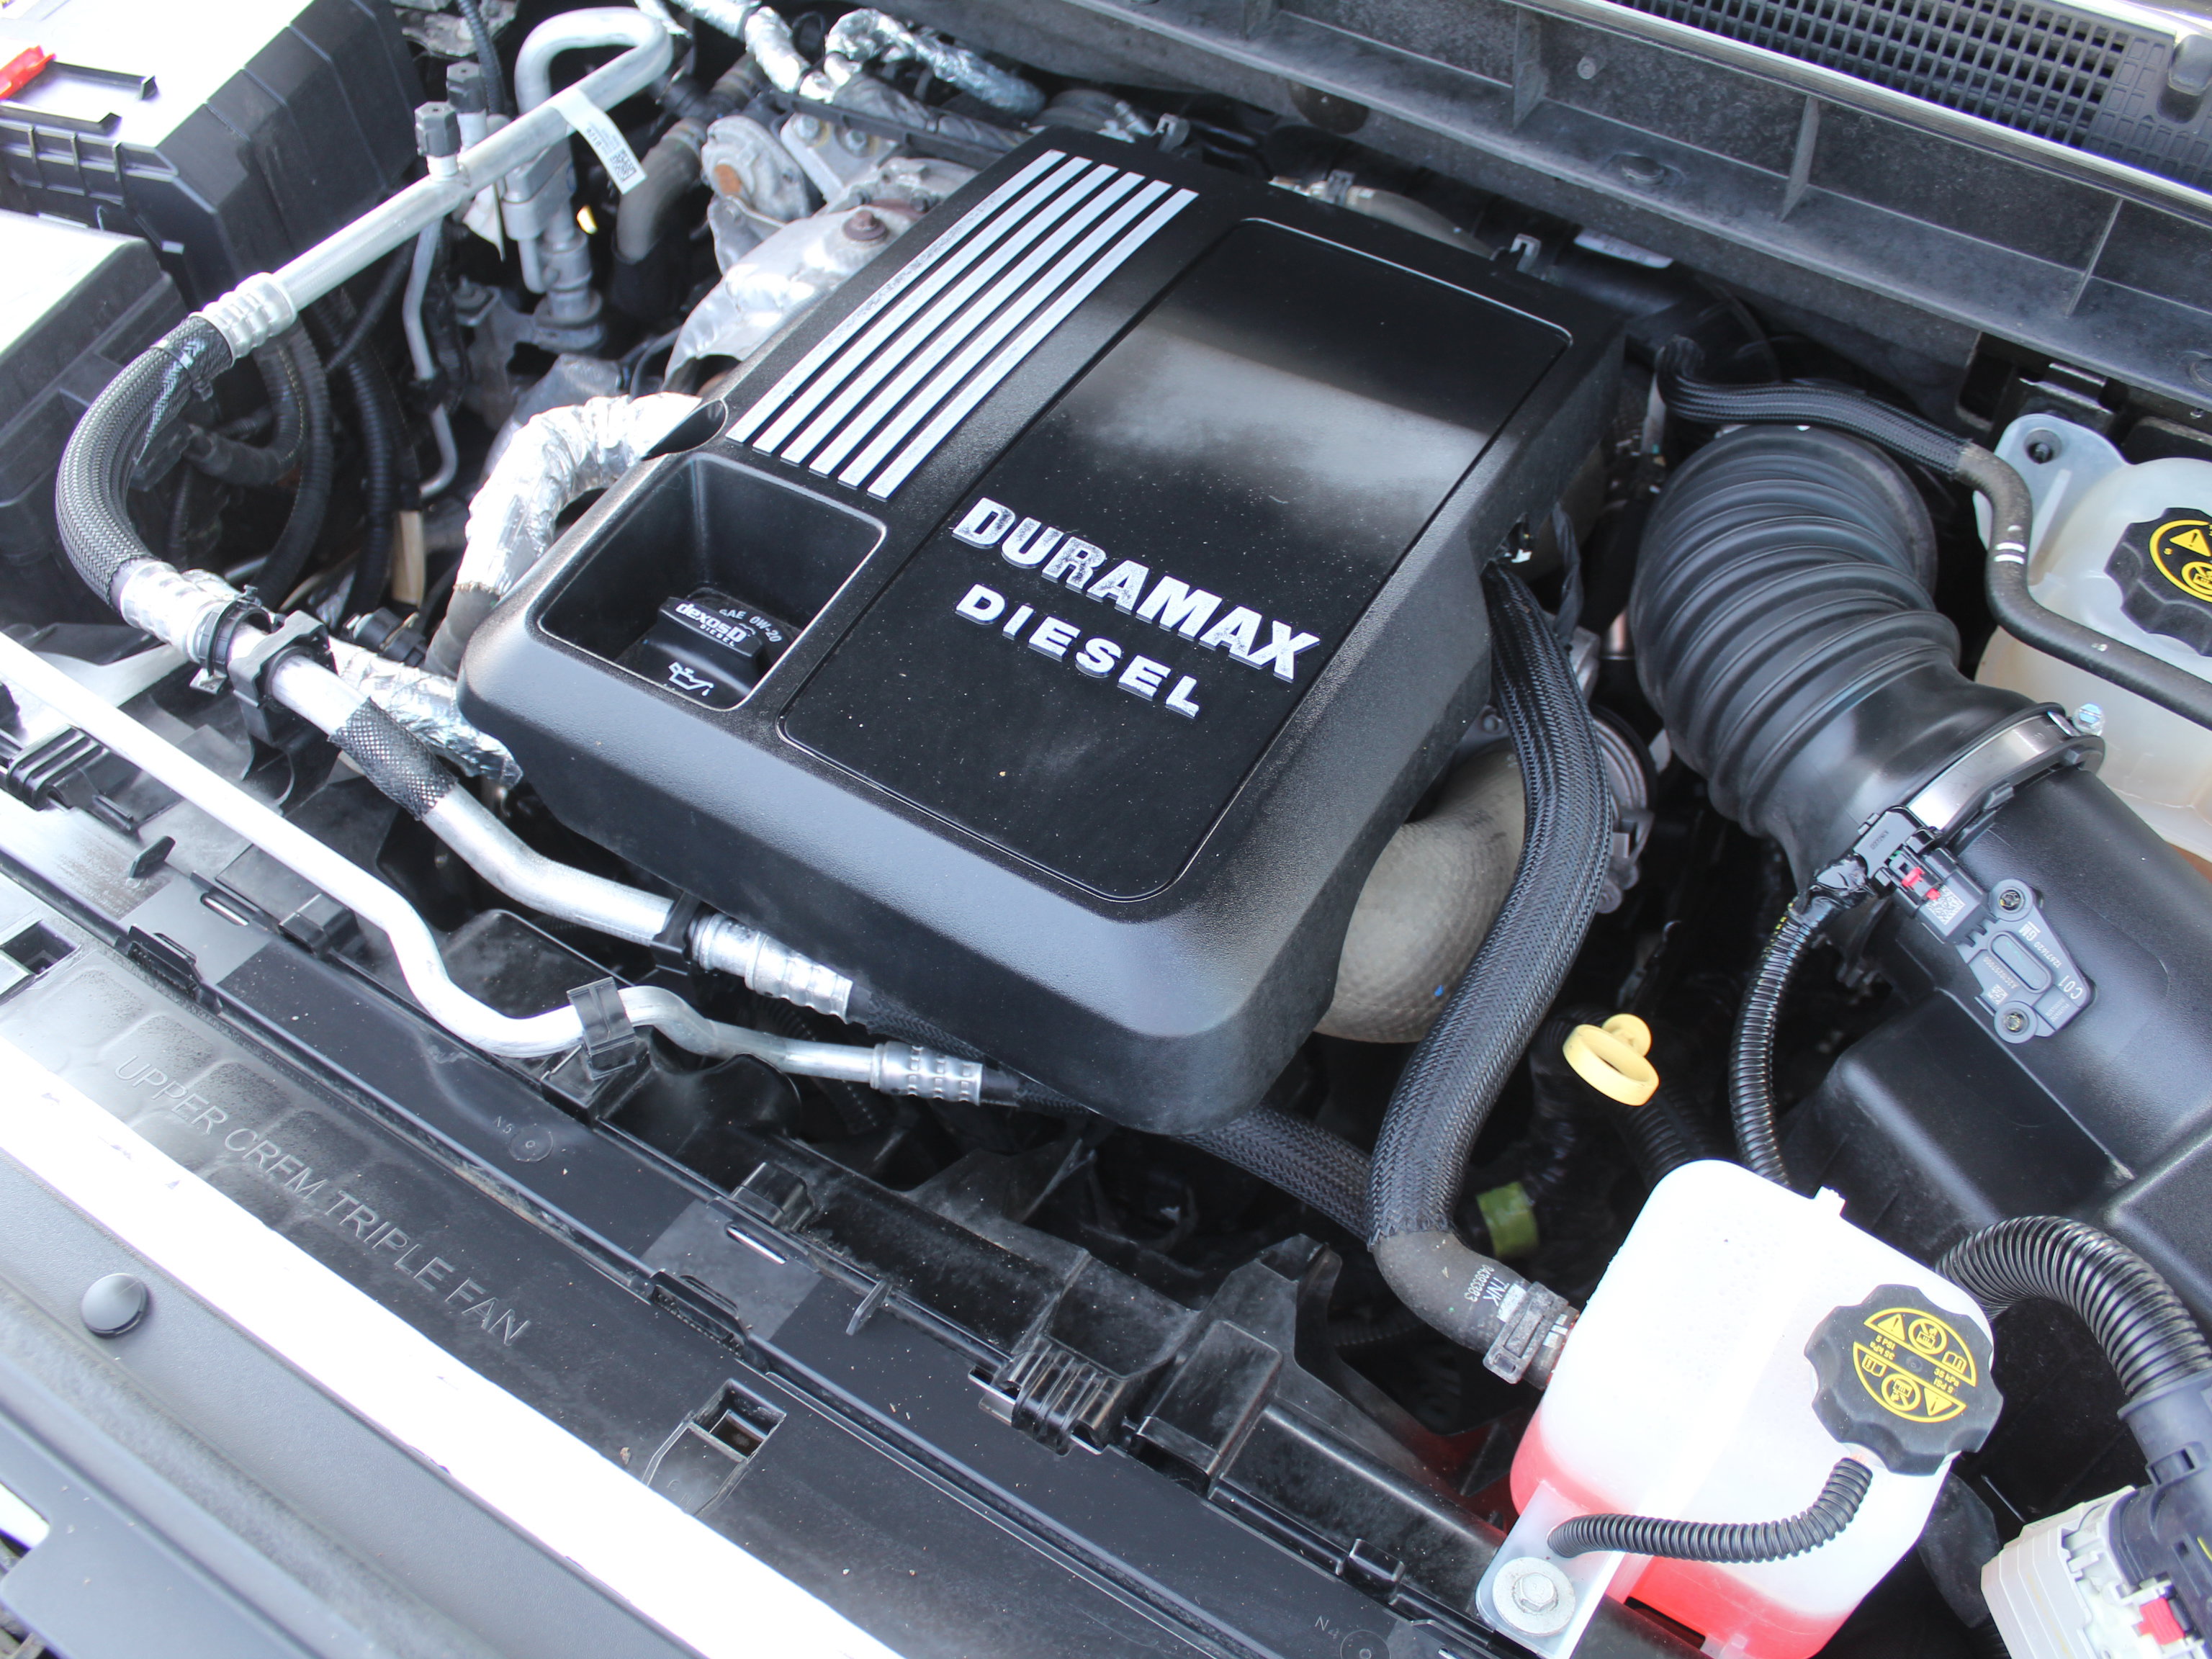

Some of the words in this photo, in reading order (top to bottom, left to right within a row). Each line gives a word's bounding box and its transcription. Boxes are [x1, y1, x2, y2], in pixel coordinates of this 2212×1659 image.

[951, 497, 1320, 683] DURAMAX
[700, 625, 735, 647] DIESEL
[719, 609, 747, 619] SAE
[750, 616, 782, 642] 0W-20
[956, 583, 1199, 718] DIESEL
[2018, 922, 2039, 941] GM
[2059, 975, 2083, 999] C01
[115, 1055, 228, 1136] UPPER
[225, 1128, 328, 1200] CRFM
[325, 1190, 456, 1291] TRIPLE
[444, 1277, 531, 1346] FAN
[1483, 1277, 1510, 1307] TNK
[1870, 1341, 1884, 1354] kPa
[1882, 1338, 1895, 1350] PSI
[1884, 1350, 1895, 1360] 35
[1933, 1377, 1947, 1390] PSI
[1934, 1367, 1945, 1378] 35
[1945, 1373, 1960, 1387] kPa
